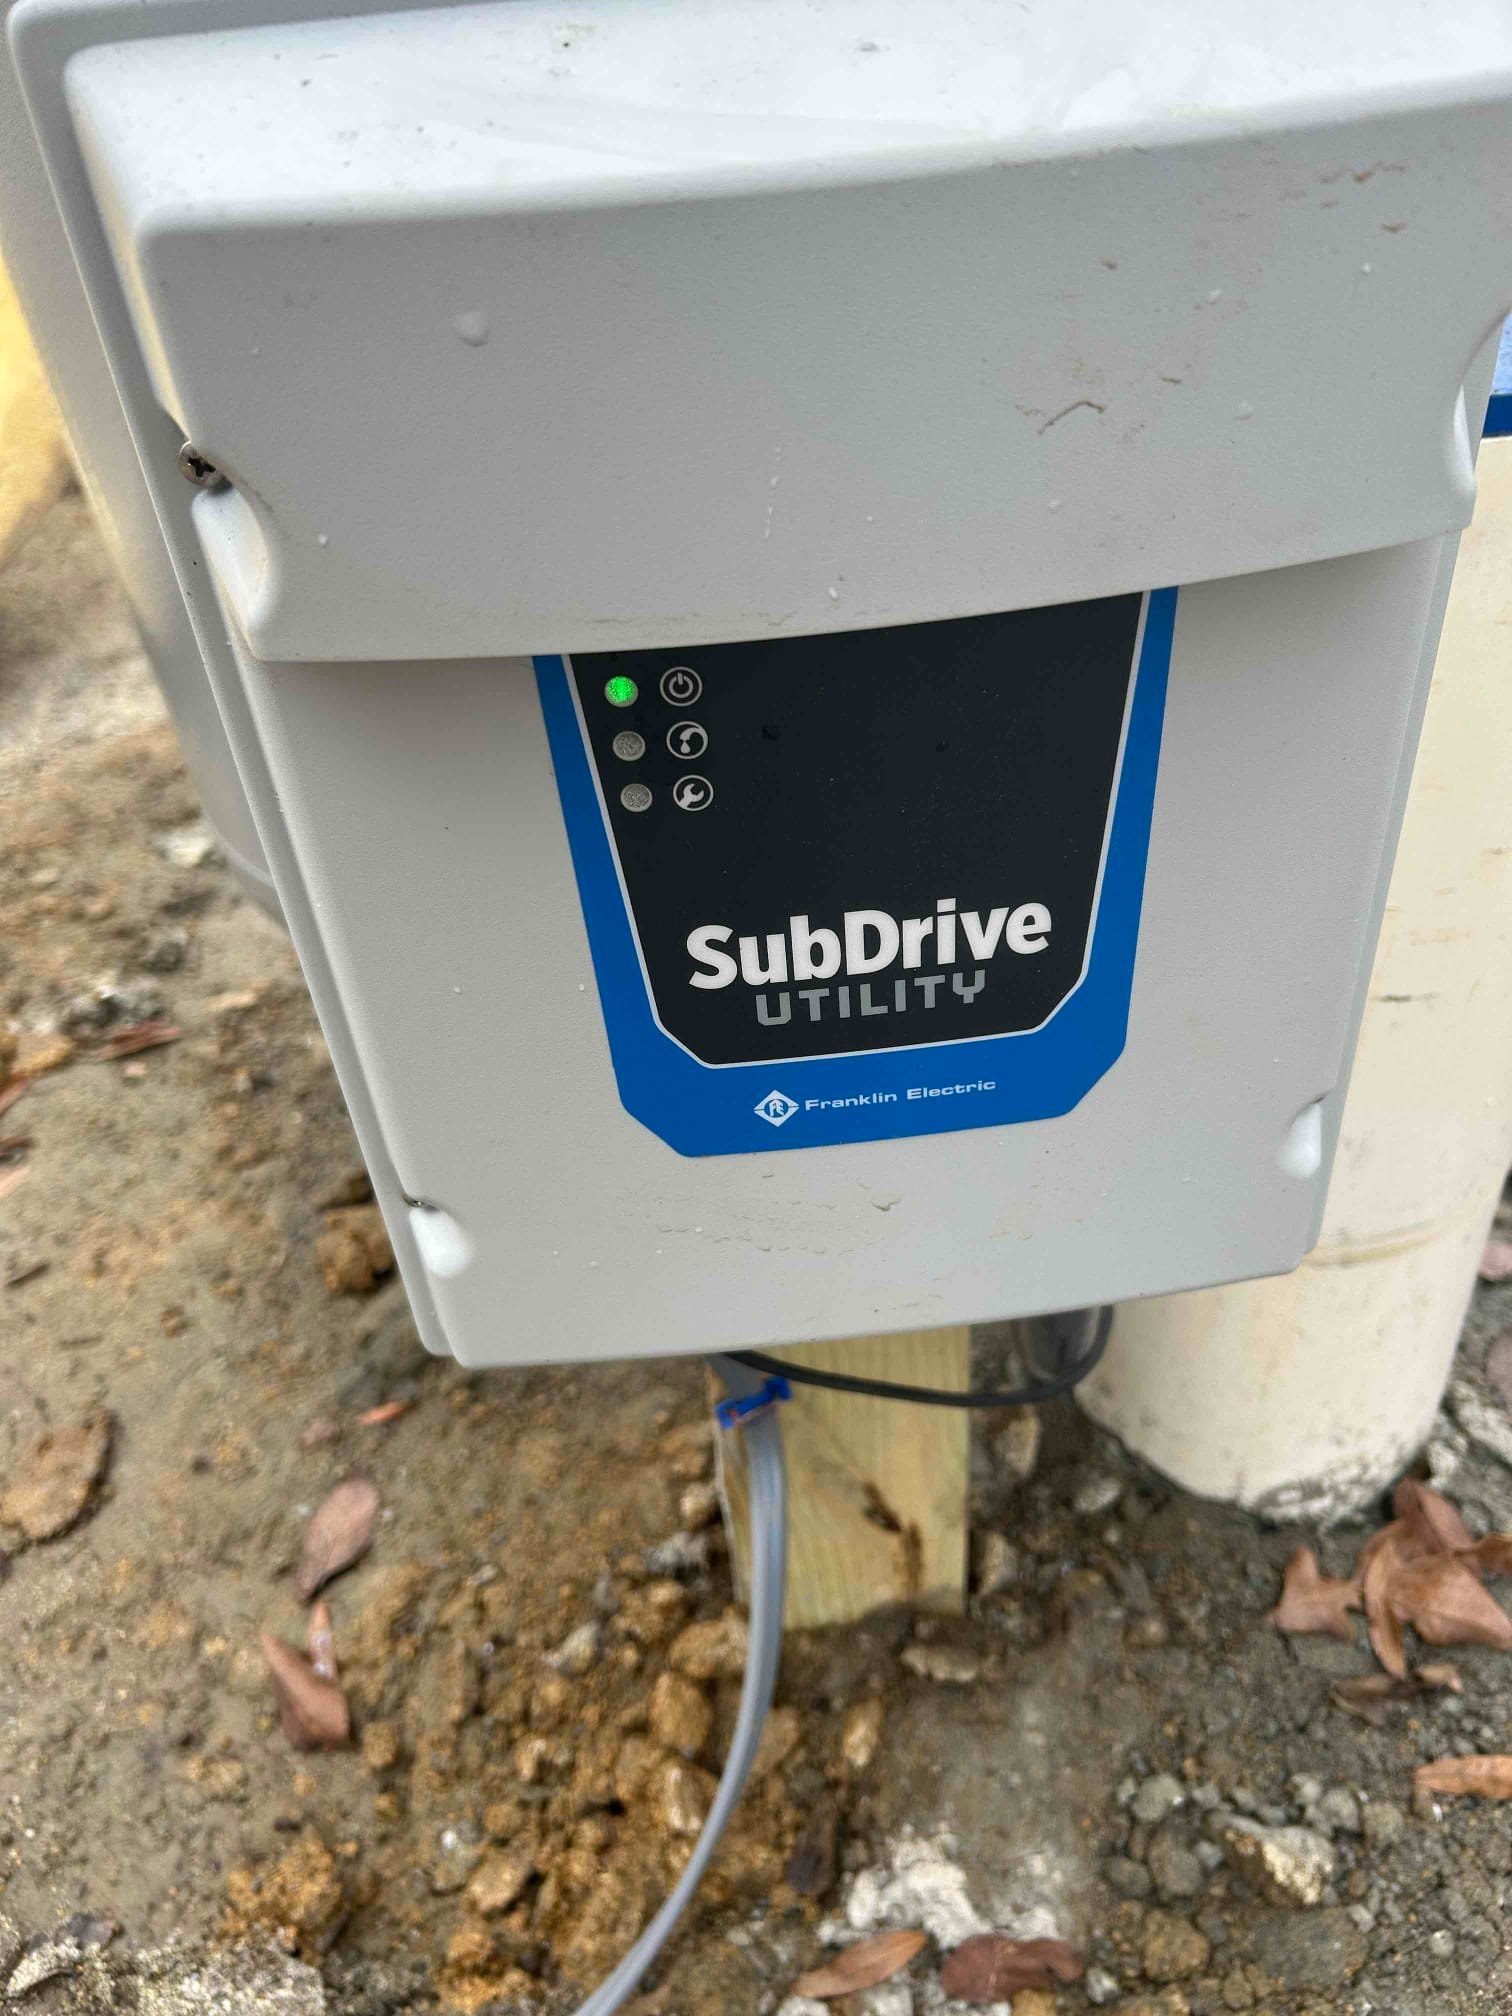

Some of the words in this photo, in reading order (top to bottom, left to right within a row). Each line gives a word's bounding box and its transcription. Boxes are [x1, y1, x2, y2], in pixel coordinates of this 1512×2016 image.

[686, 898, 1052, 990] SubDrive
[755, 969, 986, 1026] UTILITY
[805, 1092, 897, 1111] Franklin
[906, 1080, 996, 1100] Electric
